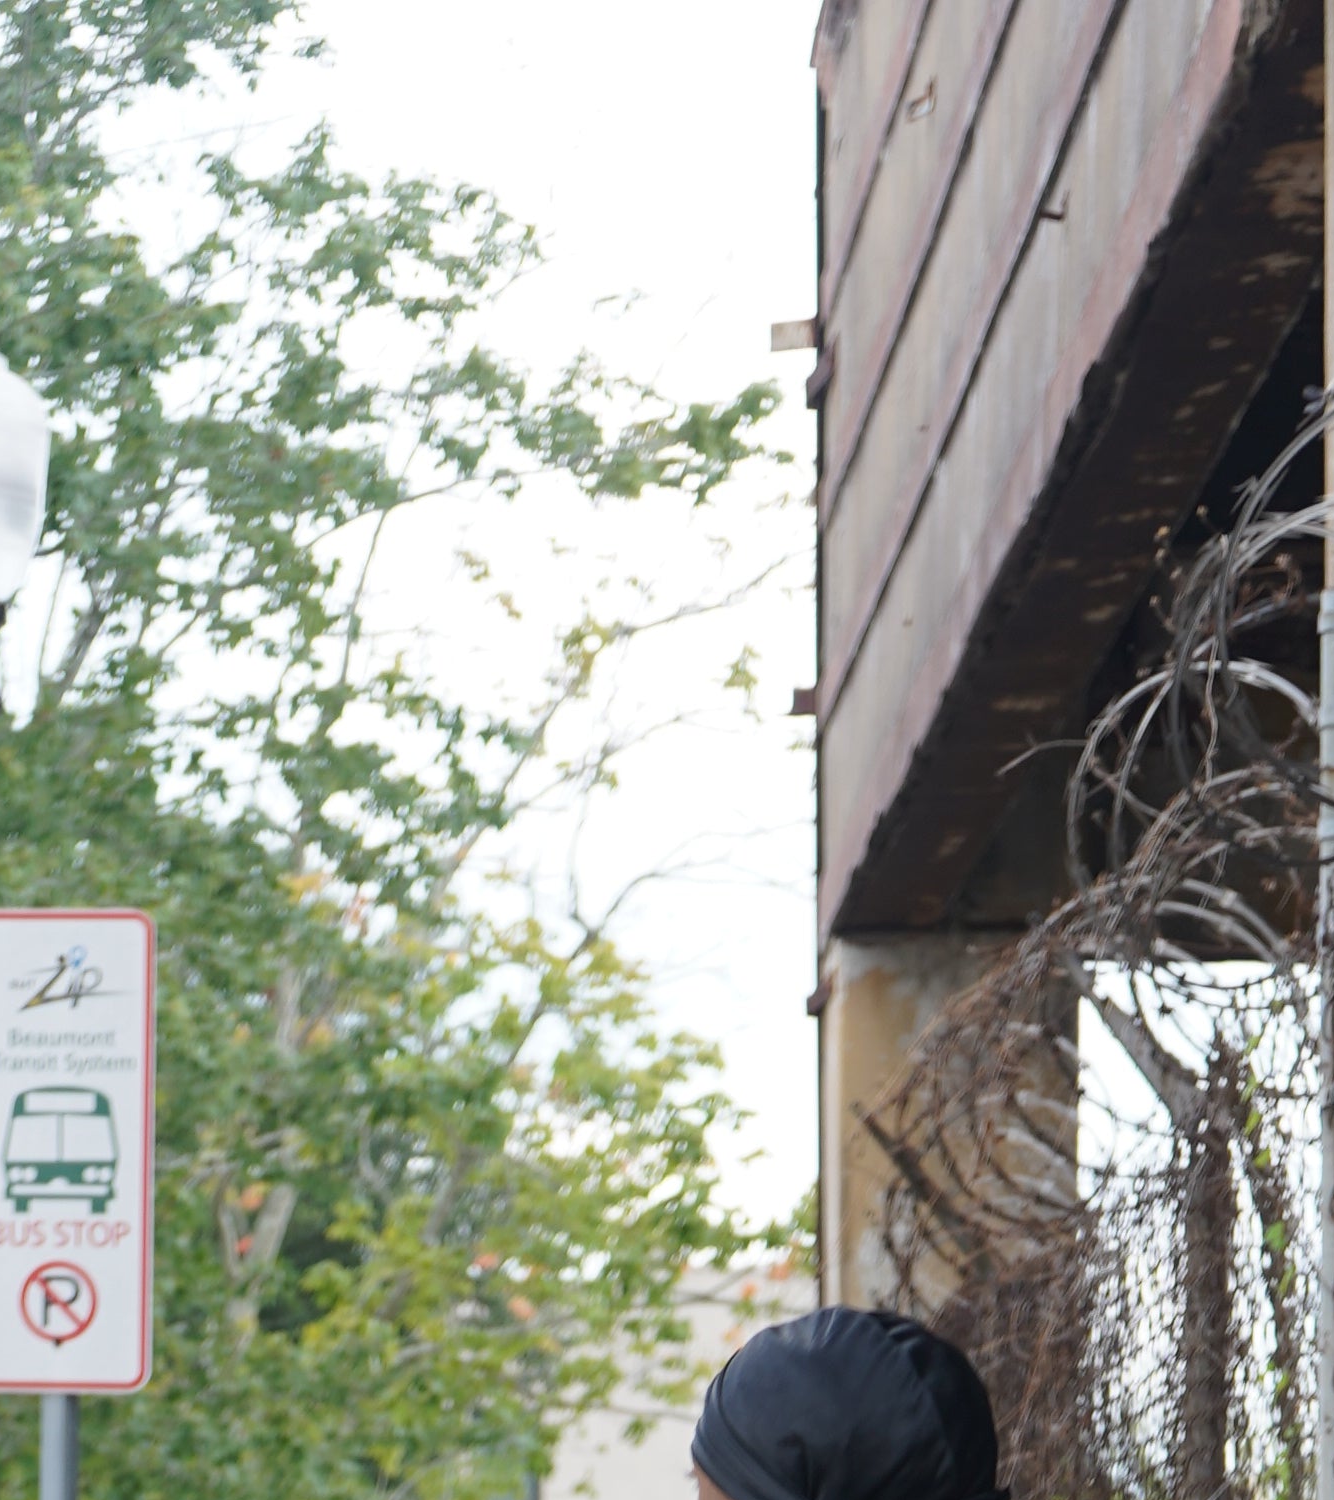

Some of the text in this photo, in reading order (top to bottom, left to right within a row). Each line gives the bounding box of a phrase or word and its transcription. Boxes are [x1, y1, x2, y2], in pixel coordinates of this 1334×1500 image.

[7, 1029, 116, 1048] Beaumont
[64, 1053, 138, 1077] System
[53, 1220, 131, 1247] STOP
